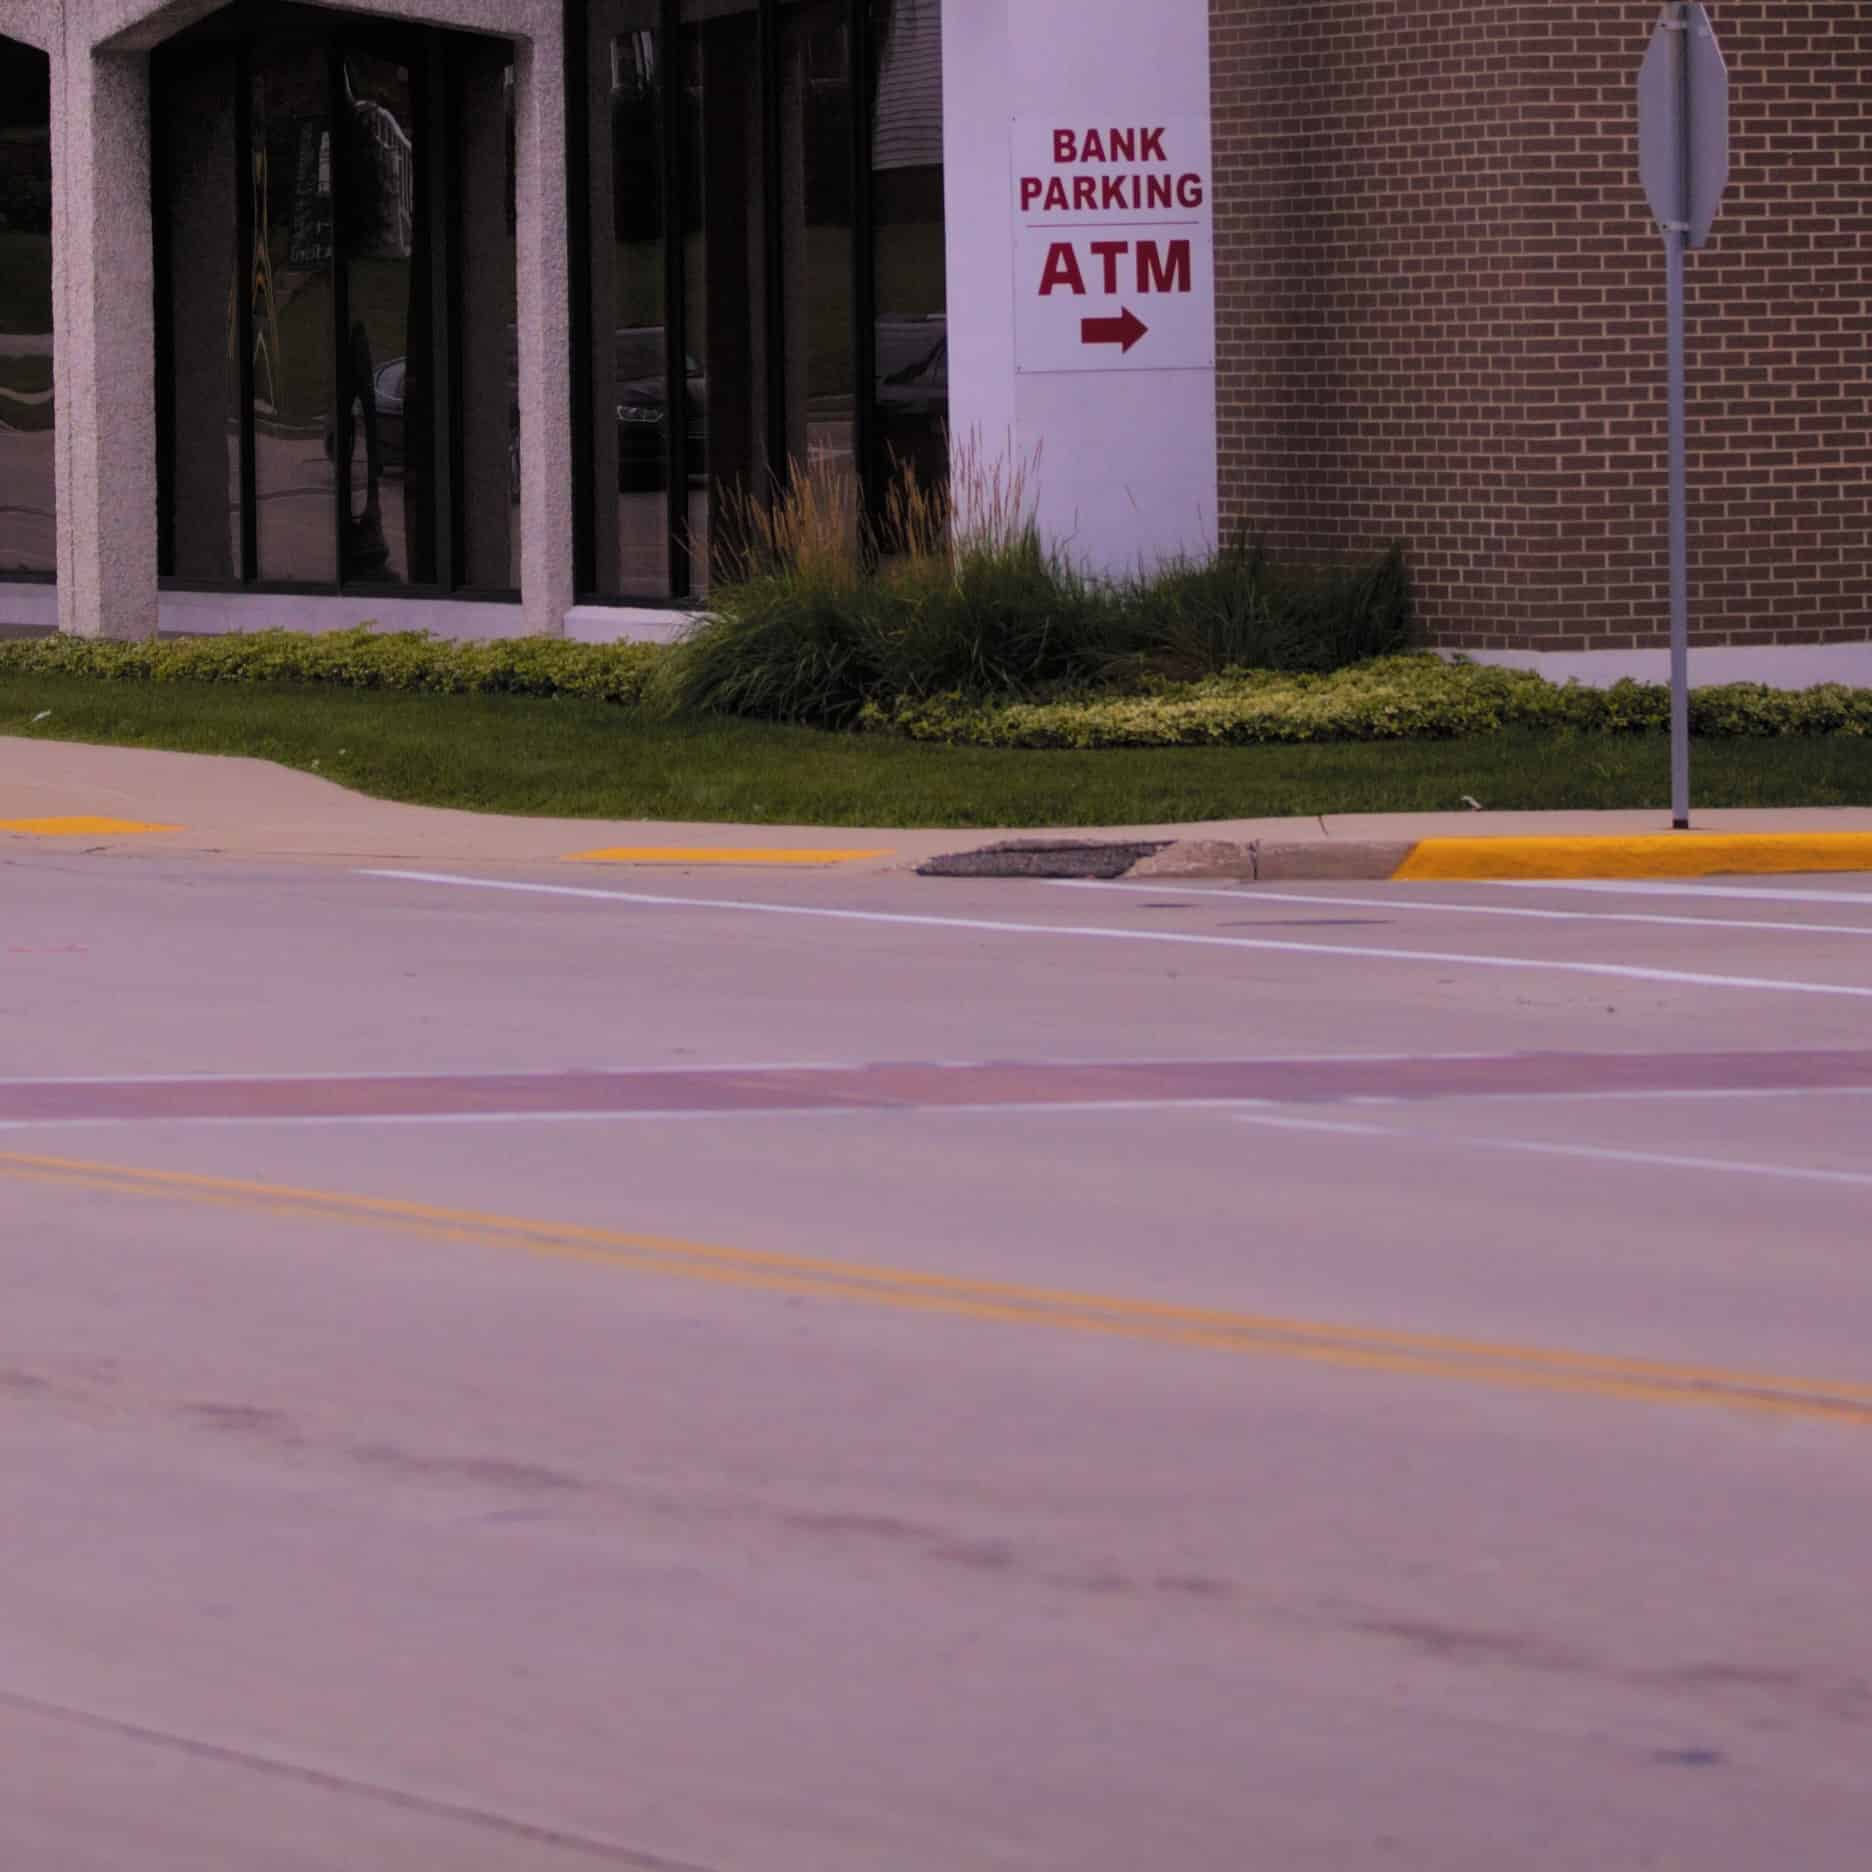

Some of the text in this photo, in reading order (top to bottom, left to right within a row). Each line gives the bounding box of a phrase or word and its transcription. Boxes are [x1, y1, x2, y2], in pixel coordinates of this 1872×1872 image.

[1053, 127, 1168, 163] BANK
[1020, 173, 1204, 211] PARKING
[1038, 239, 1192, 296] ATM
